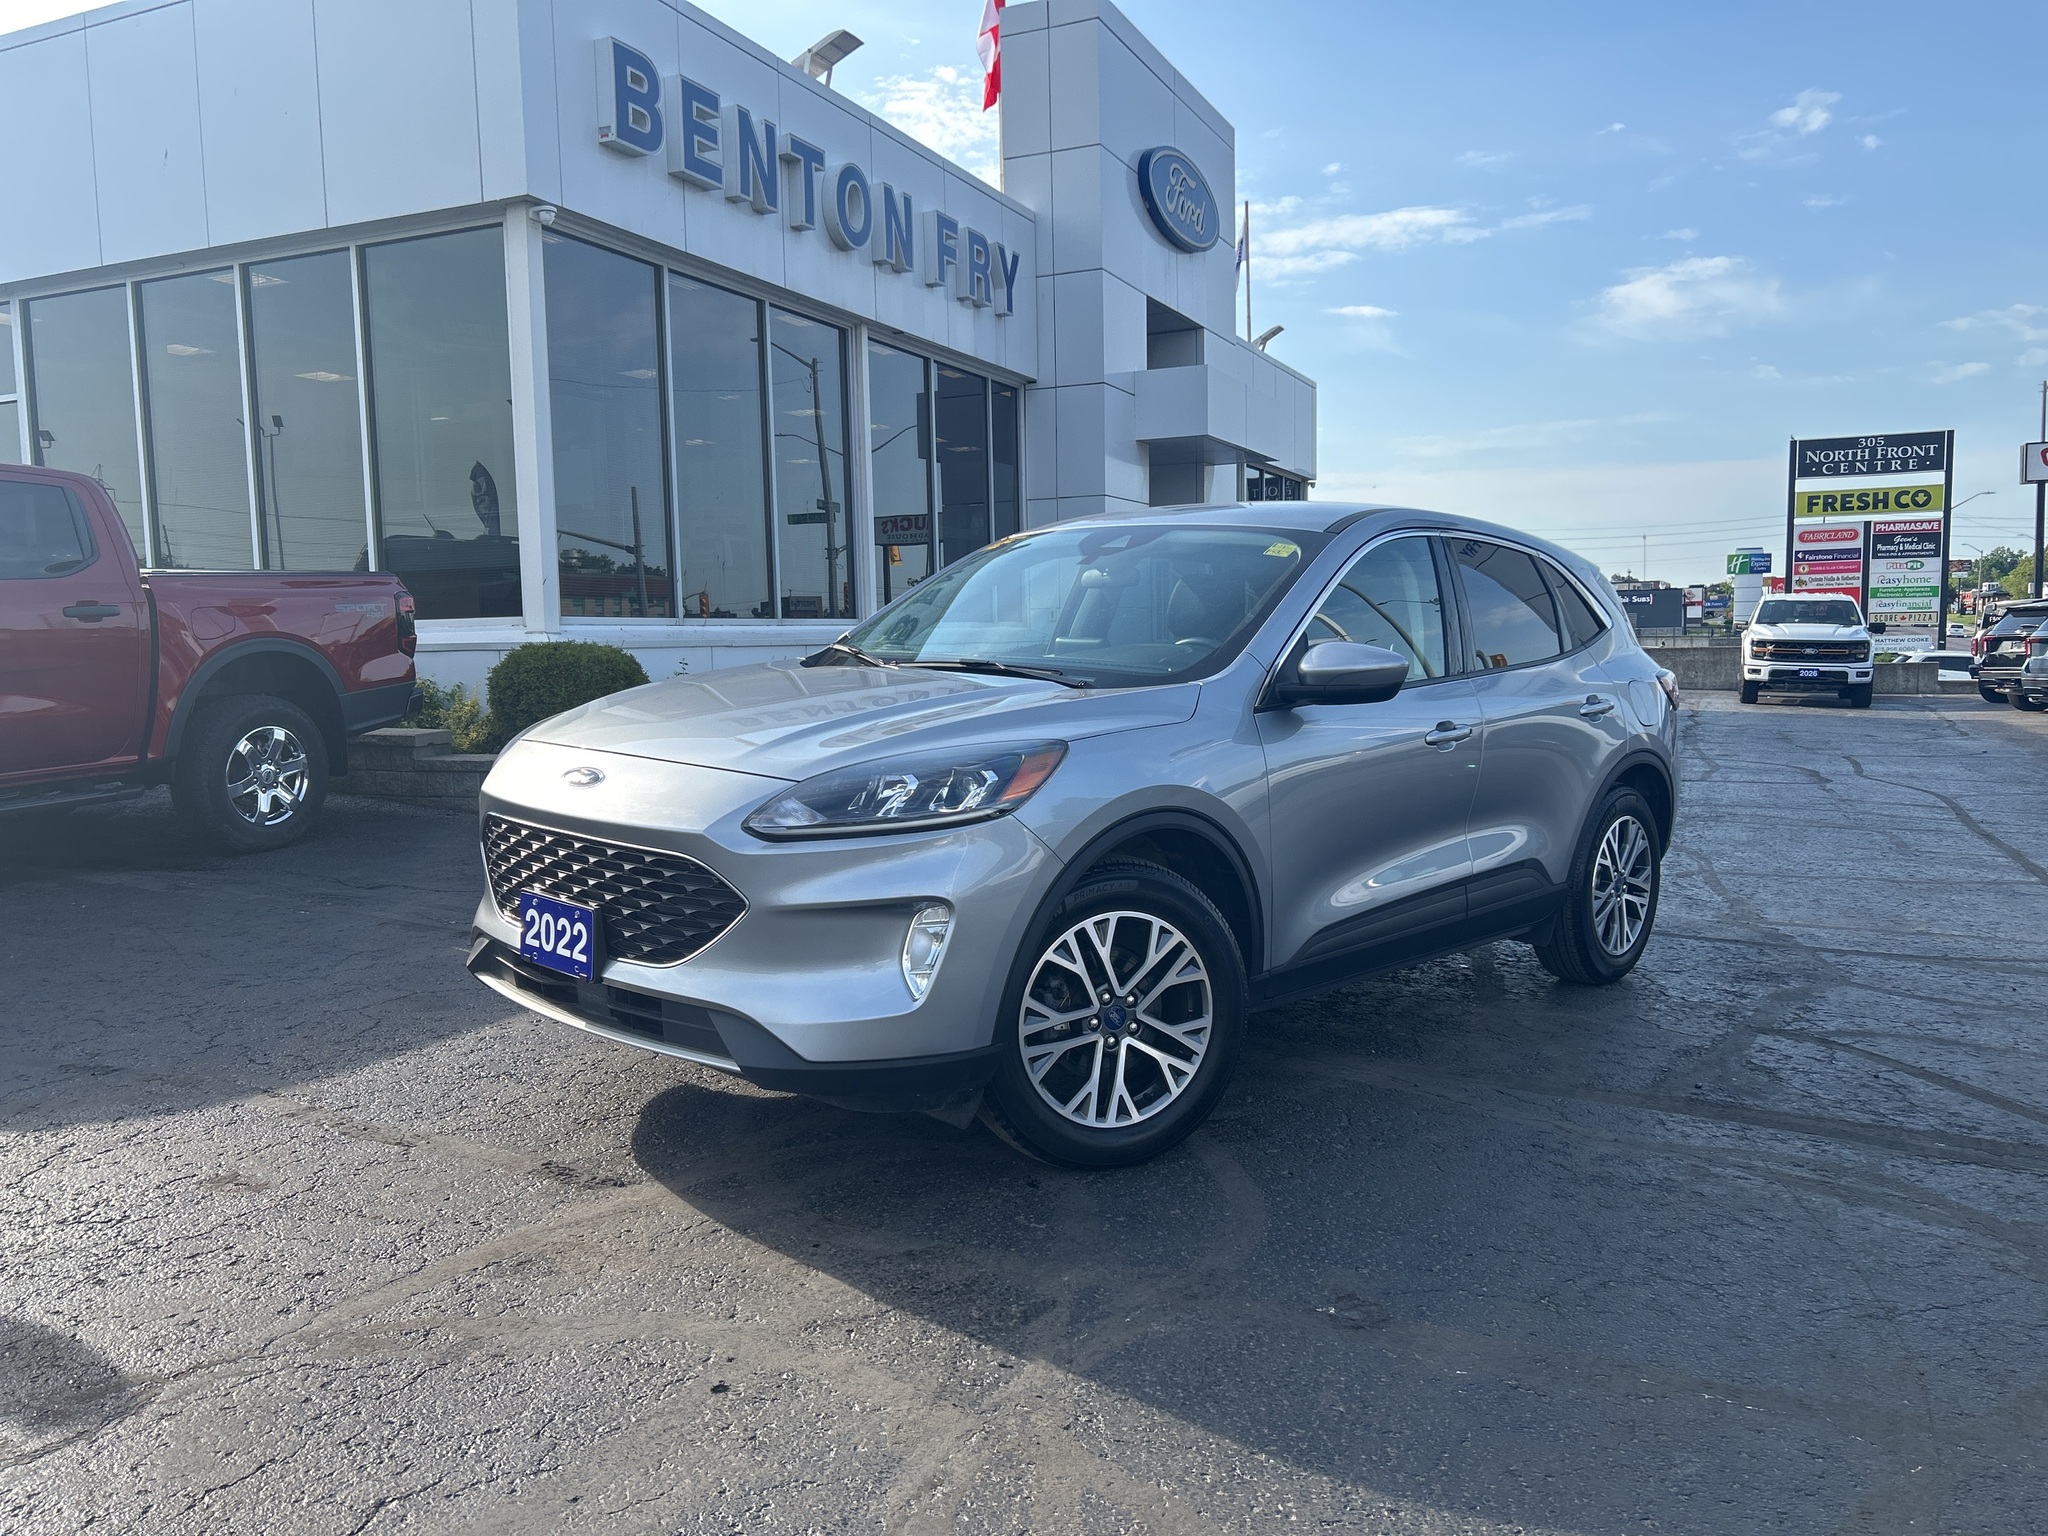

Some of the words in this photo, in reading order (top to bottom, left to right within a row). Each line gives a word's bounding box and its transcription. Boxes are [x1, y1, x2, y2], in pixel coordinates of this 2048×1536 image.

[600, 36, 914, 273] BENTON
[923, 210, 1020, 317] FRY
[1165, 162, 1206, 236] Ford
[1858, 437, 1885, 447] 305
[1806, 449, 1870, 463] NORTH
[1876, 444, 1938, 459] FRONT
[1822, 459, 1918, 474] CENTRE
[1875, 522, 1939, 531] PHARMASAVE
[1802, 531, 1855, 541] FABRICLAND
[1877, 544, 1899, 552] Pharmacy
[335, 603, 388, 613] SPORT
[1874, 614, 1898, 622] SCORE
[1908, 614, 1933, 622] PIZZA
[1073, 883, 1115, 902] PRIMACY
[524, 908, 588, 963] 2022
